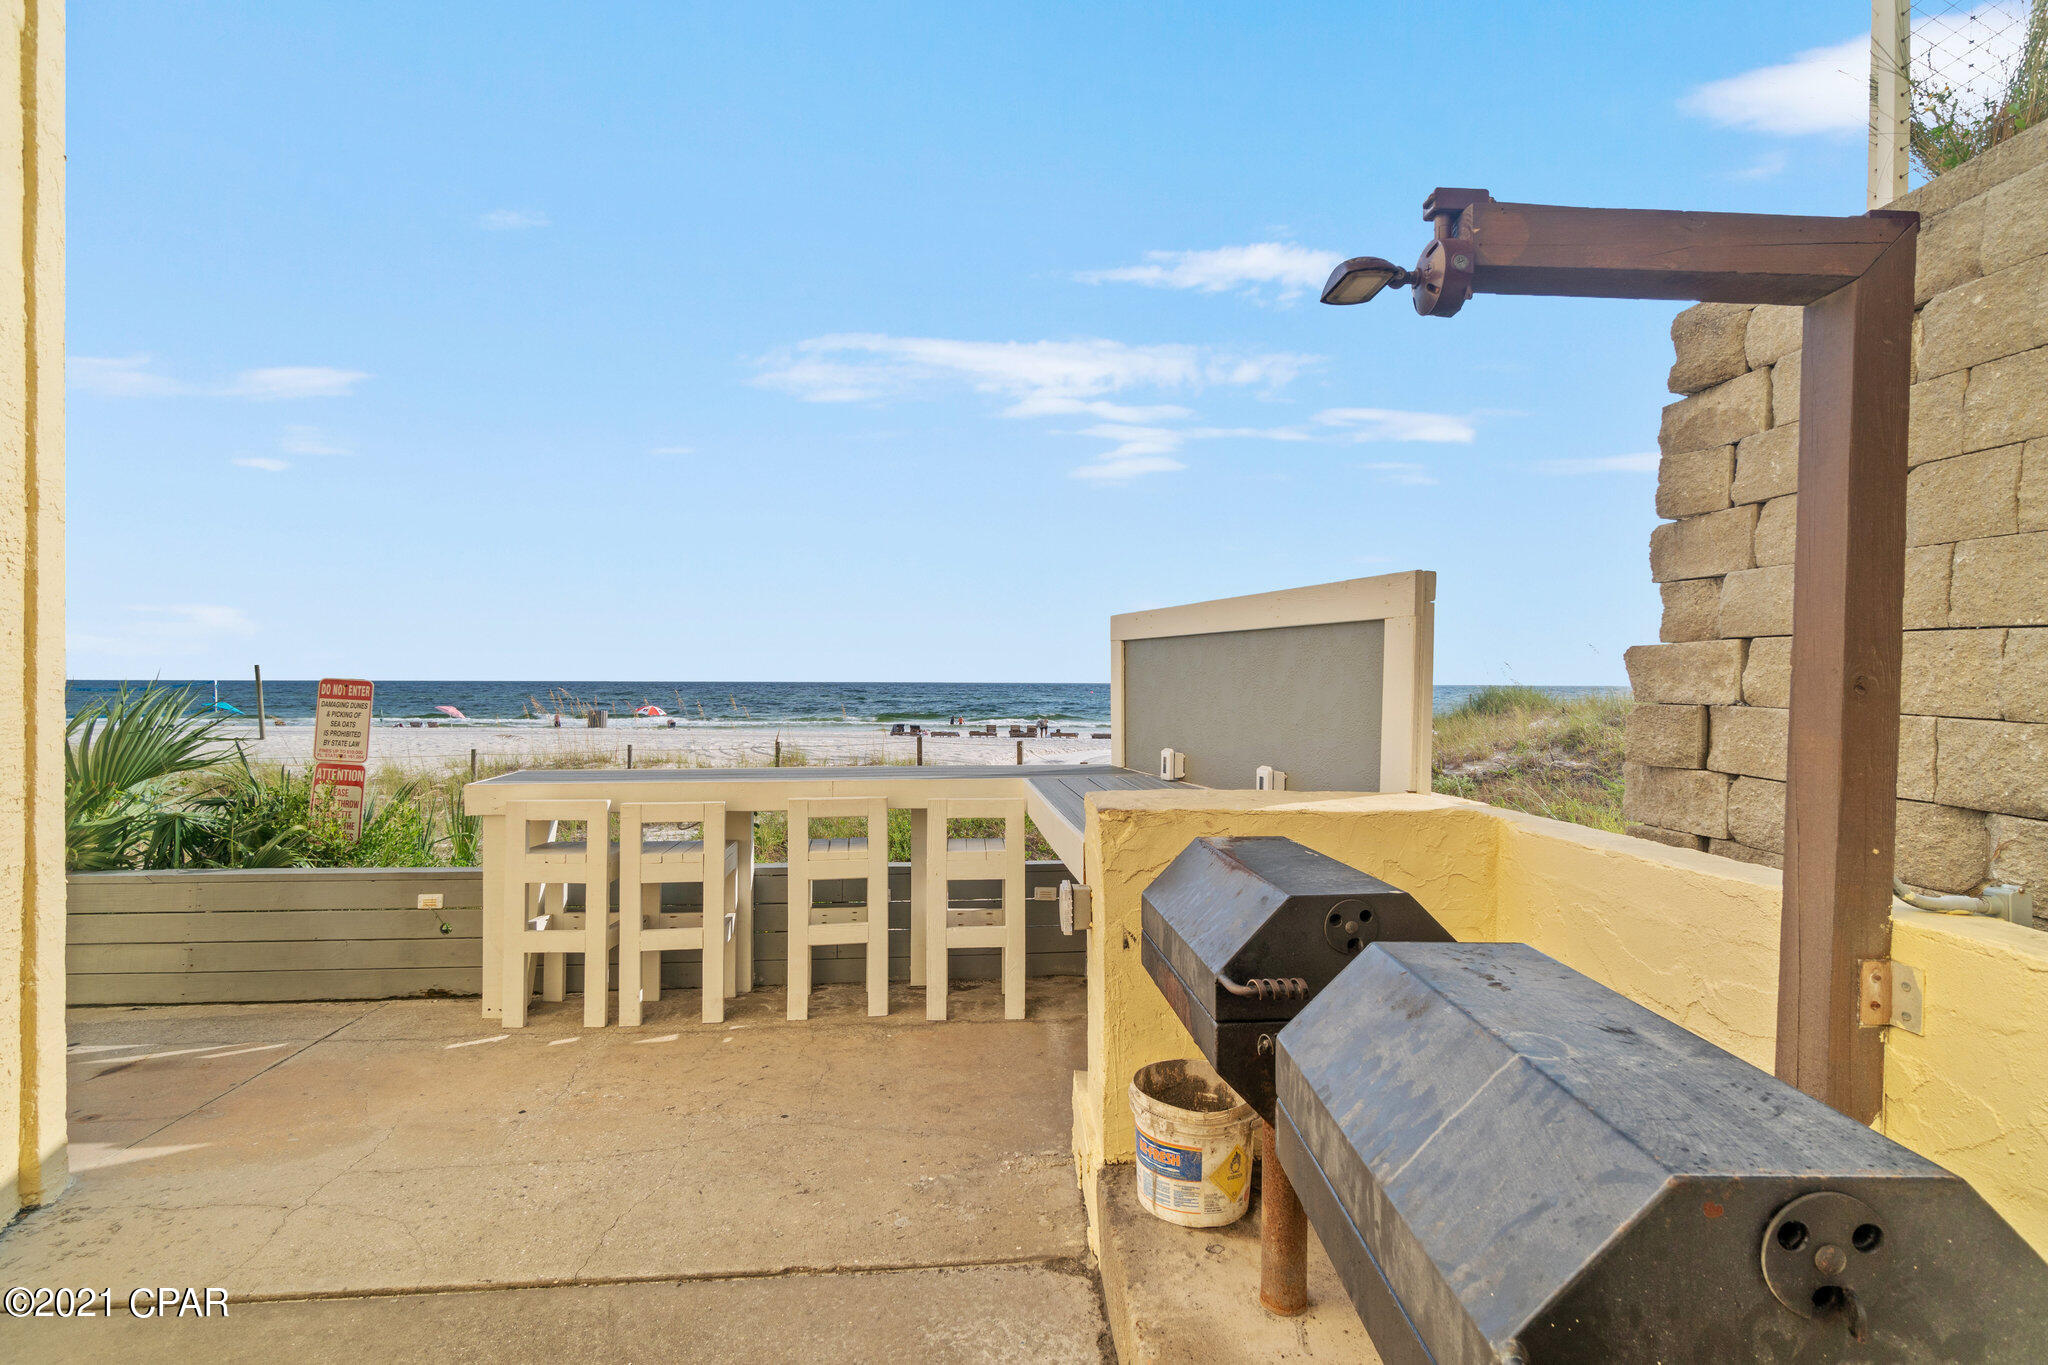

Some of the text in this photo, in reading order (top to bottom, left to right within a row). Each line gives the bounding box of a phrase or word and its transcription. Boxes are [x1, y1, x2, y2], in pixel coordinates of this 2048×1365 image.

[320, 684, 370, 697] DO NOT ENTER
[331, 710, 353, 718] PICKING
[316, 768, 364, 782] ATTENTION
[337, 800, 360, 808] THROW
